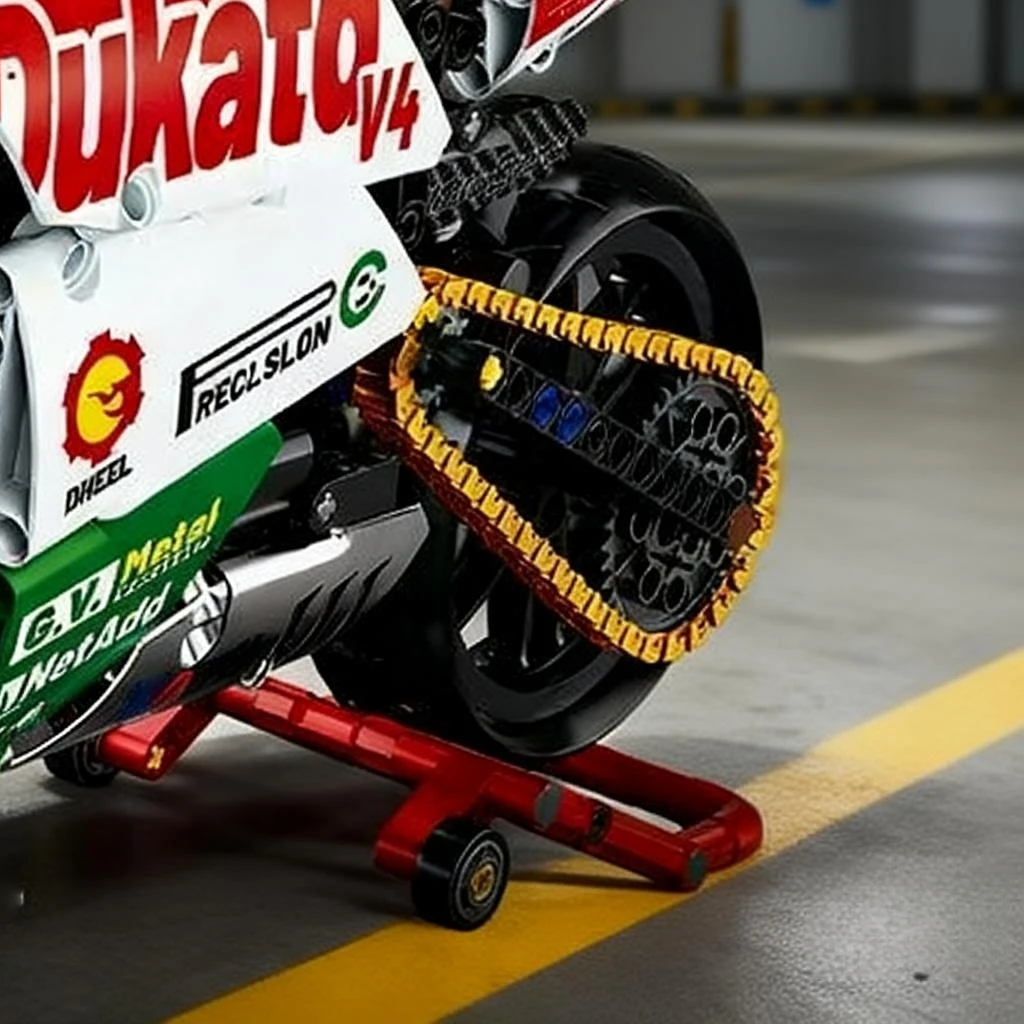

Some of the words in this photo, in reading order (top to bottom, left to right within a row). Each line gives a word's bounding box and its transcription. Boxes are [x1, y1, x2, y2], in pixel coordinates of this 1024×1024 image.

[360, 61, 420, 163] V4
[64, 454, 133, 517] DHEEL
[119, 496, 222, 588] Metal
[18, 580, 173, 704] NetAdd
